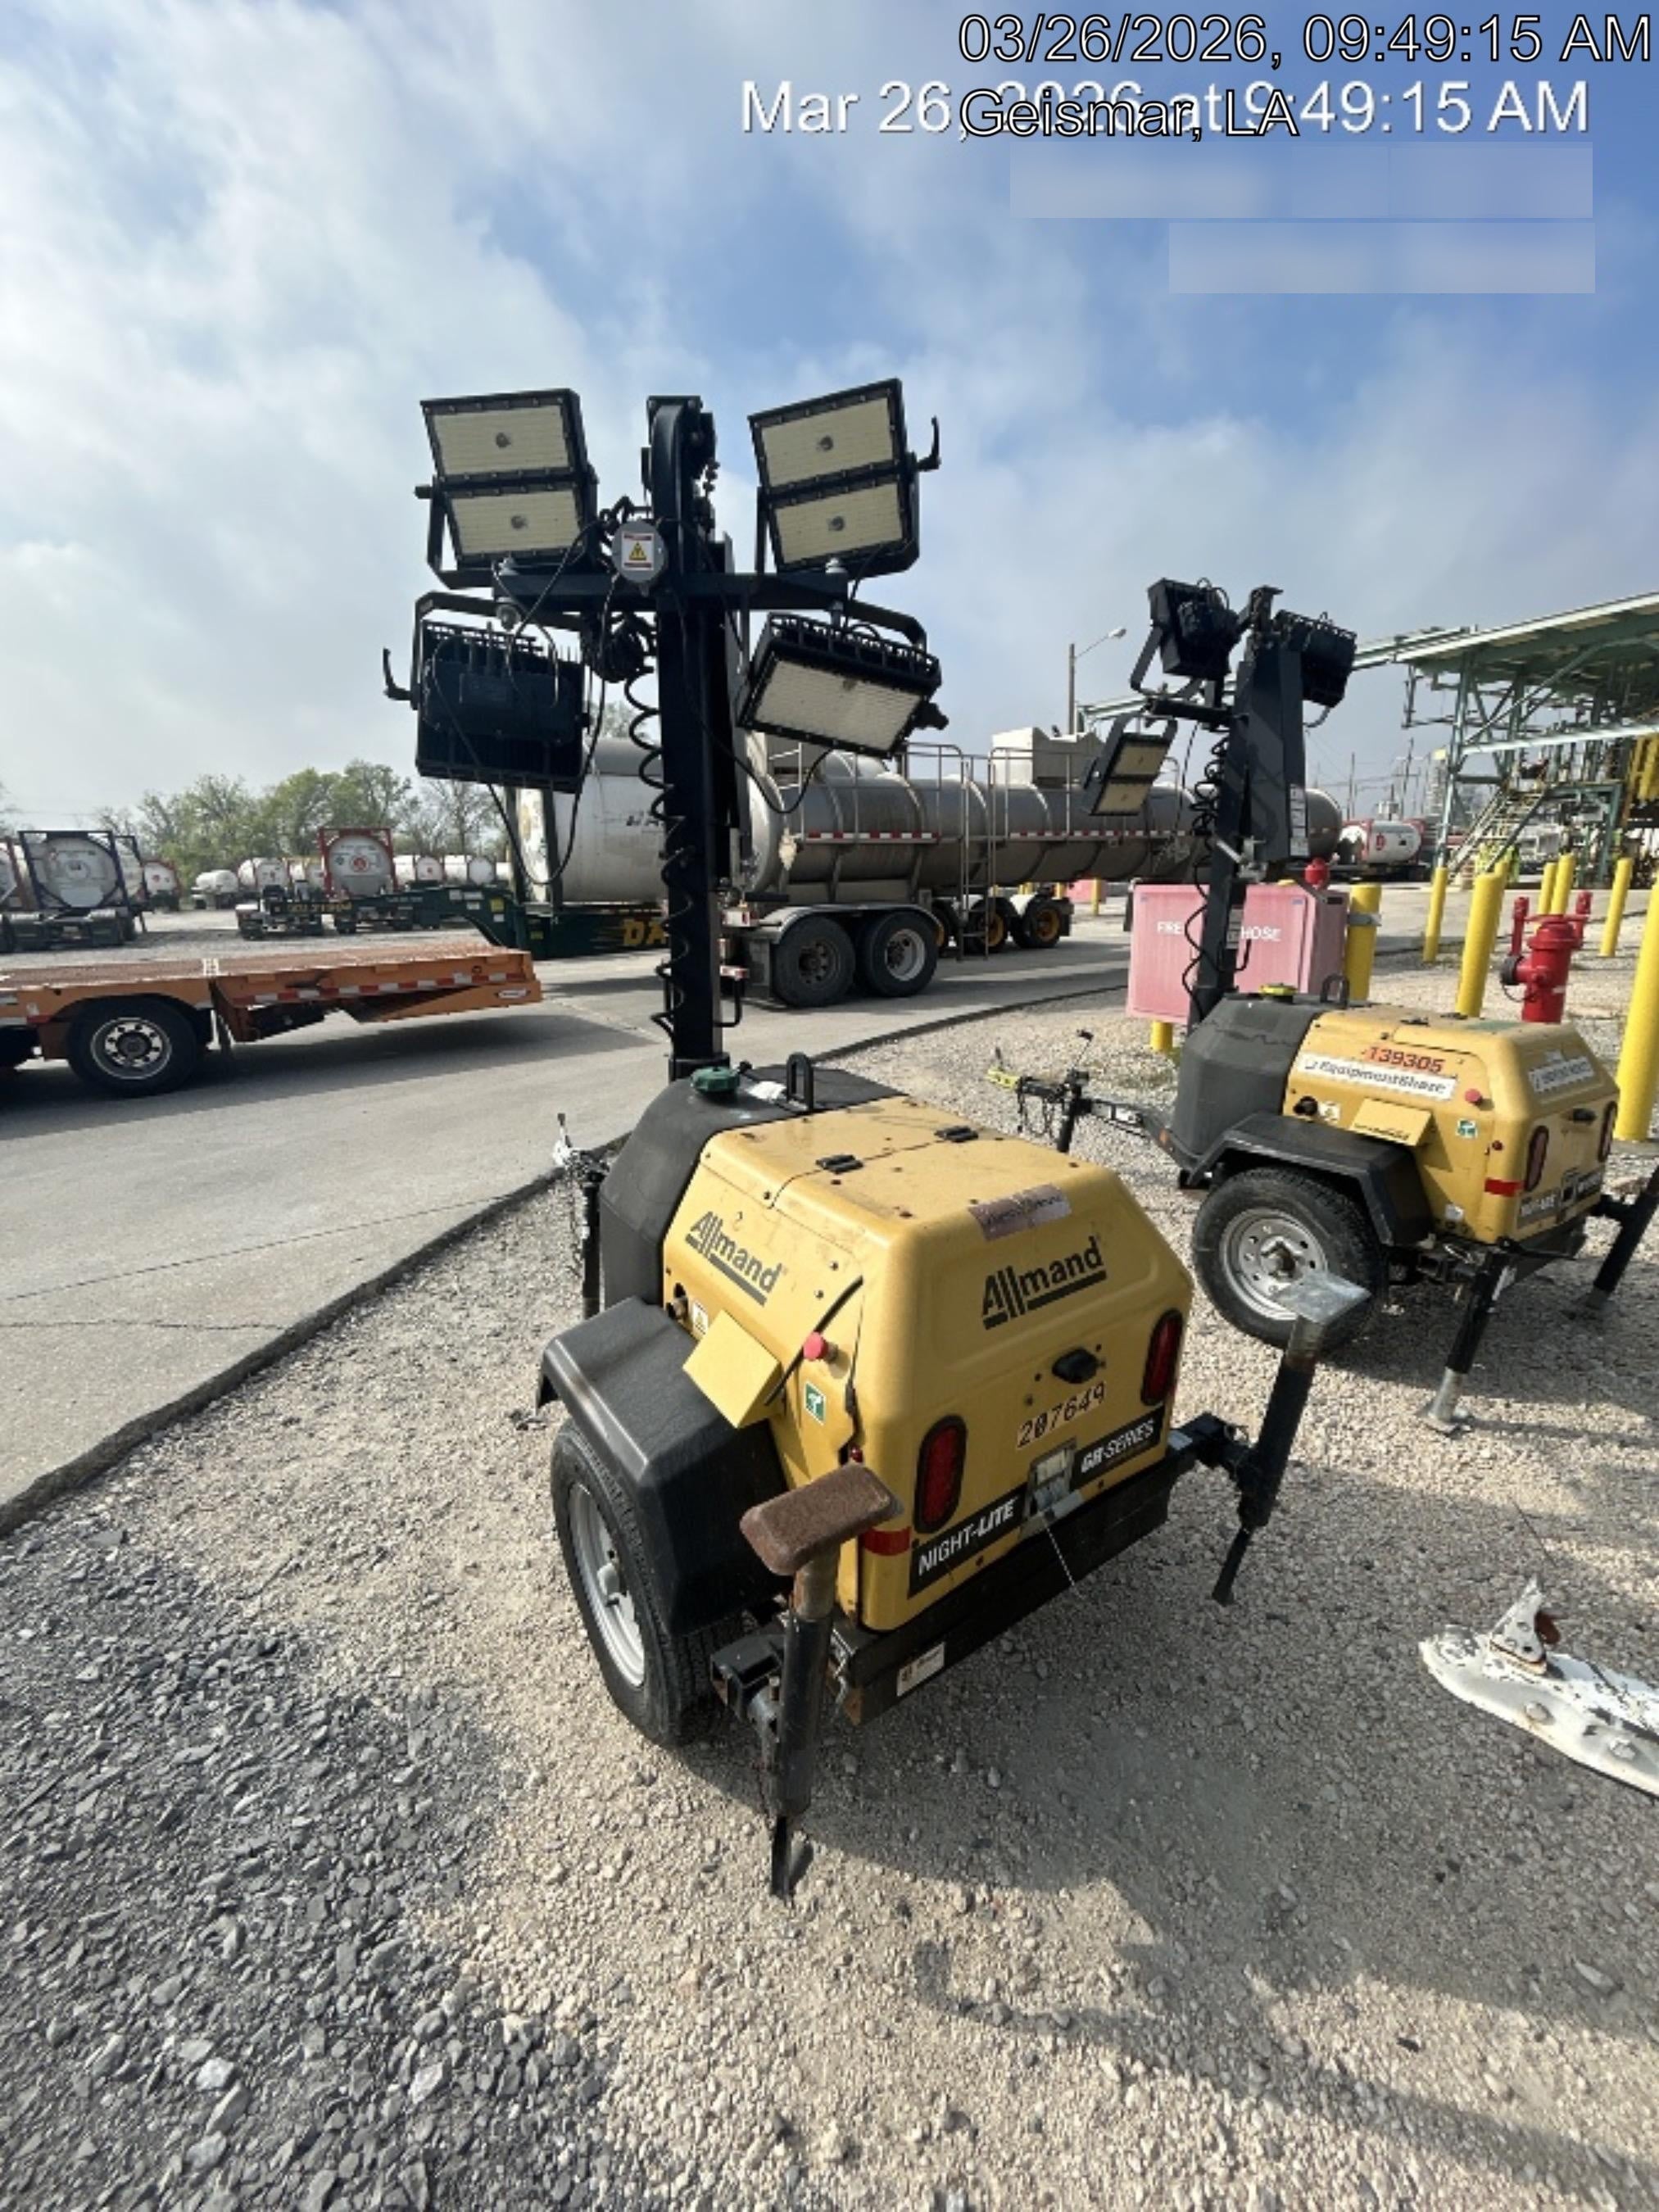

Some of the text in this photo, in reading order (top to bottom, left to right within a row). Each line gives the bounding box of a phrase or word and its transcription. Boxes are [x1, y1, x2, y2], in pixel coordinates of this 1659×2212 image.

[1157, 921, 1282, 941] FIRE HOSE
[1370, 1045, 1446, 1074] 139305
[687, 1211, 782, 1299] Allmand
[982, 1235, 1104, 1321] Allmand
[918, 1498, 1015, 1576] NIGHT-LITE
